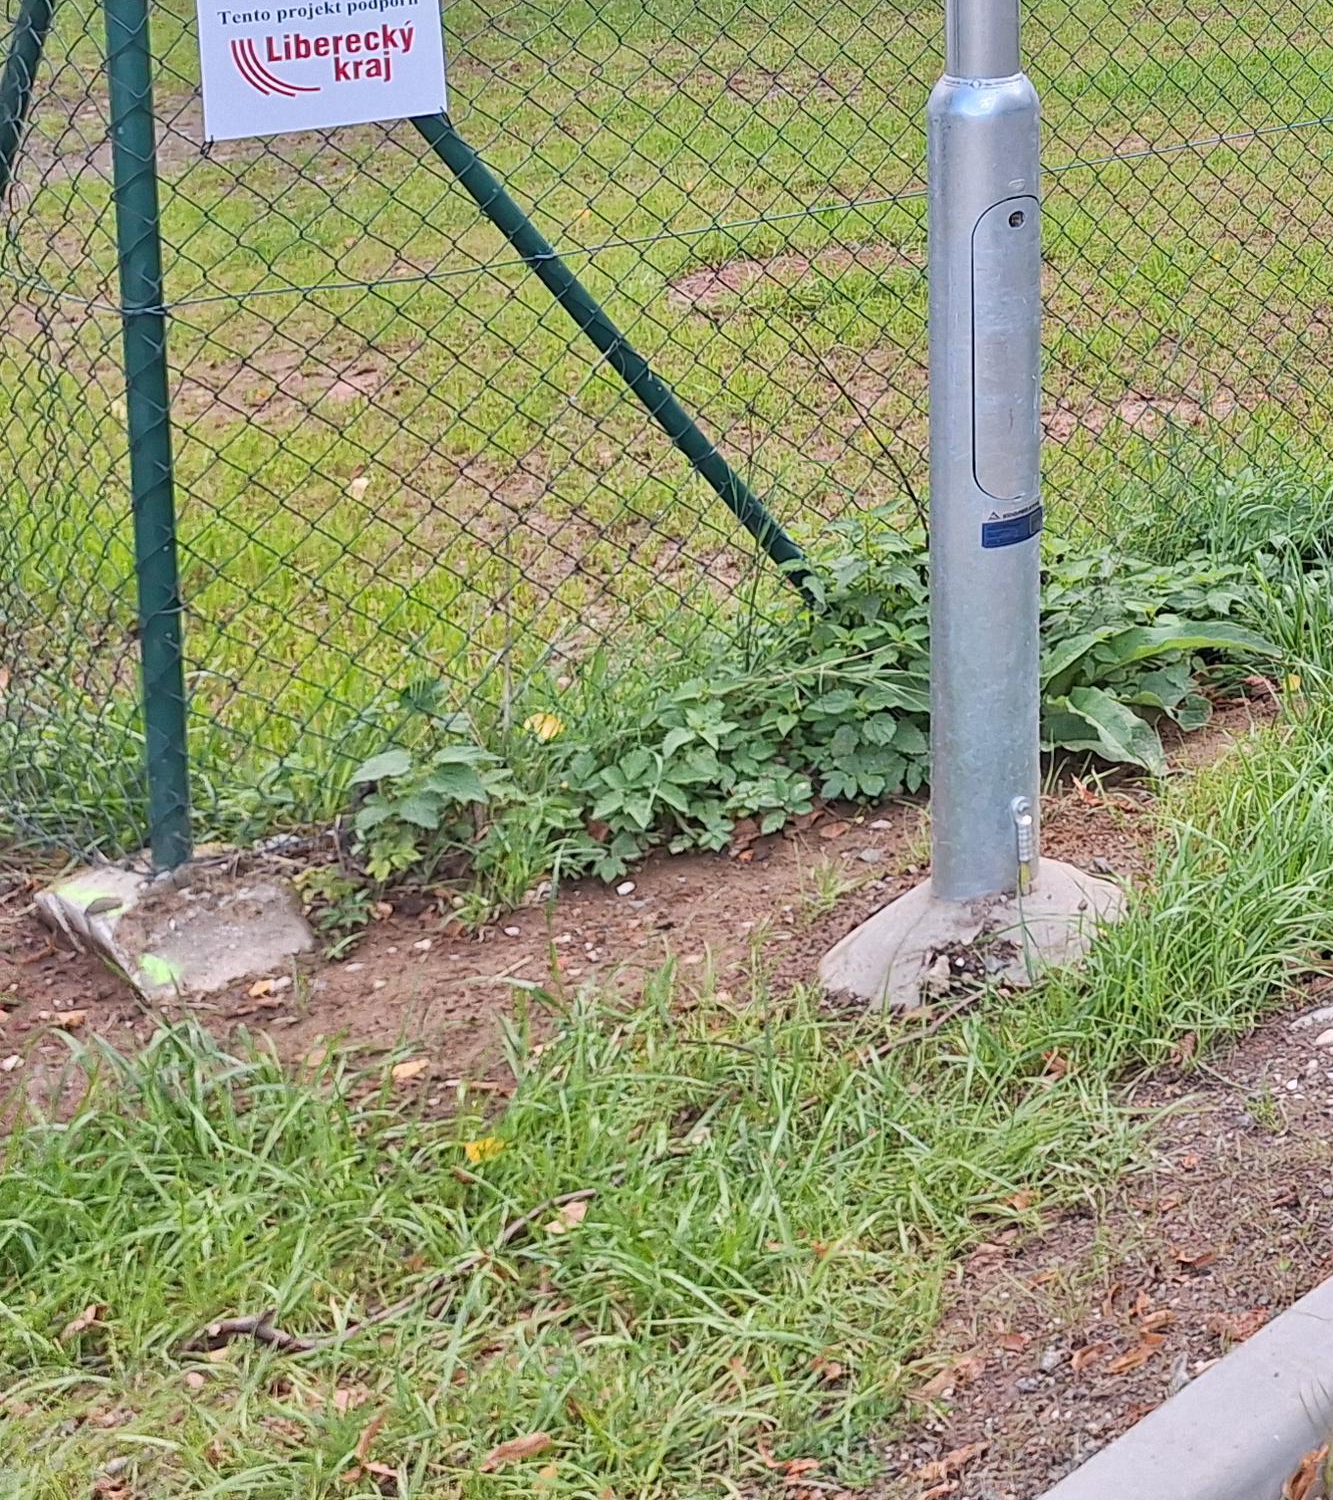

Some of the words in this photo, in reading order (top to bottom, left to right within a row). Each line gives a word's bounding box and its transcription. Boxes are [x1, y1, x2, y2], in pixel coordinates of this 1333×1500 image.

[217, 10, 271, 25] Tento
[276, 1, 341, 23] projekt
[265, 20, 414, 62] Liberecký
[334, 51, 392, 82] kraj
